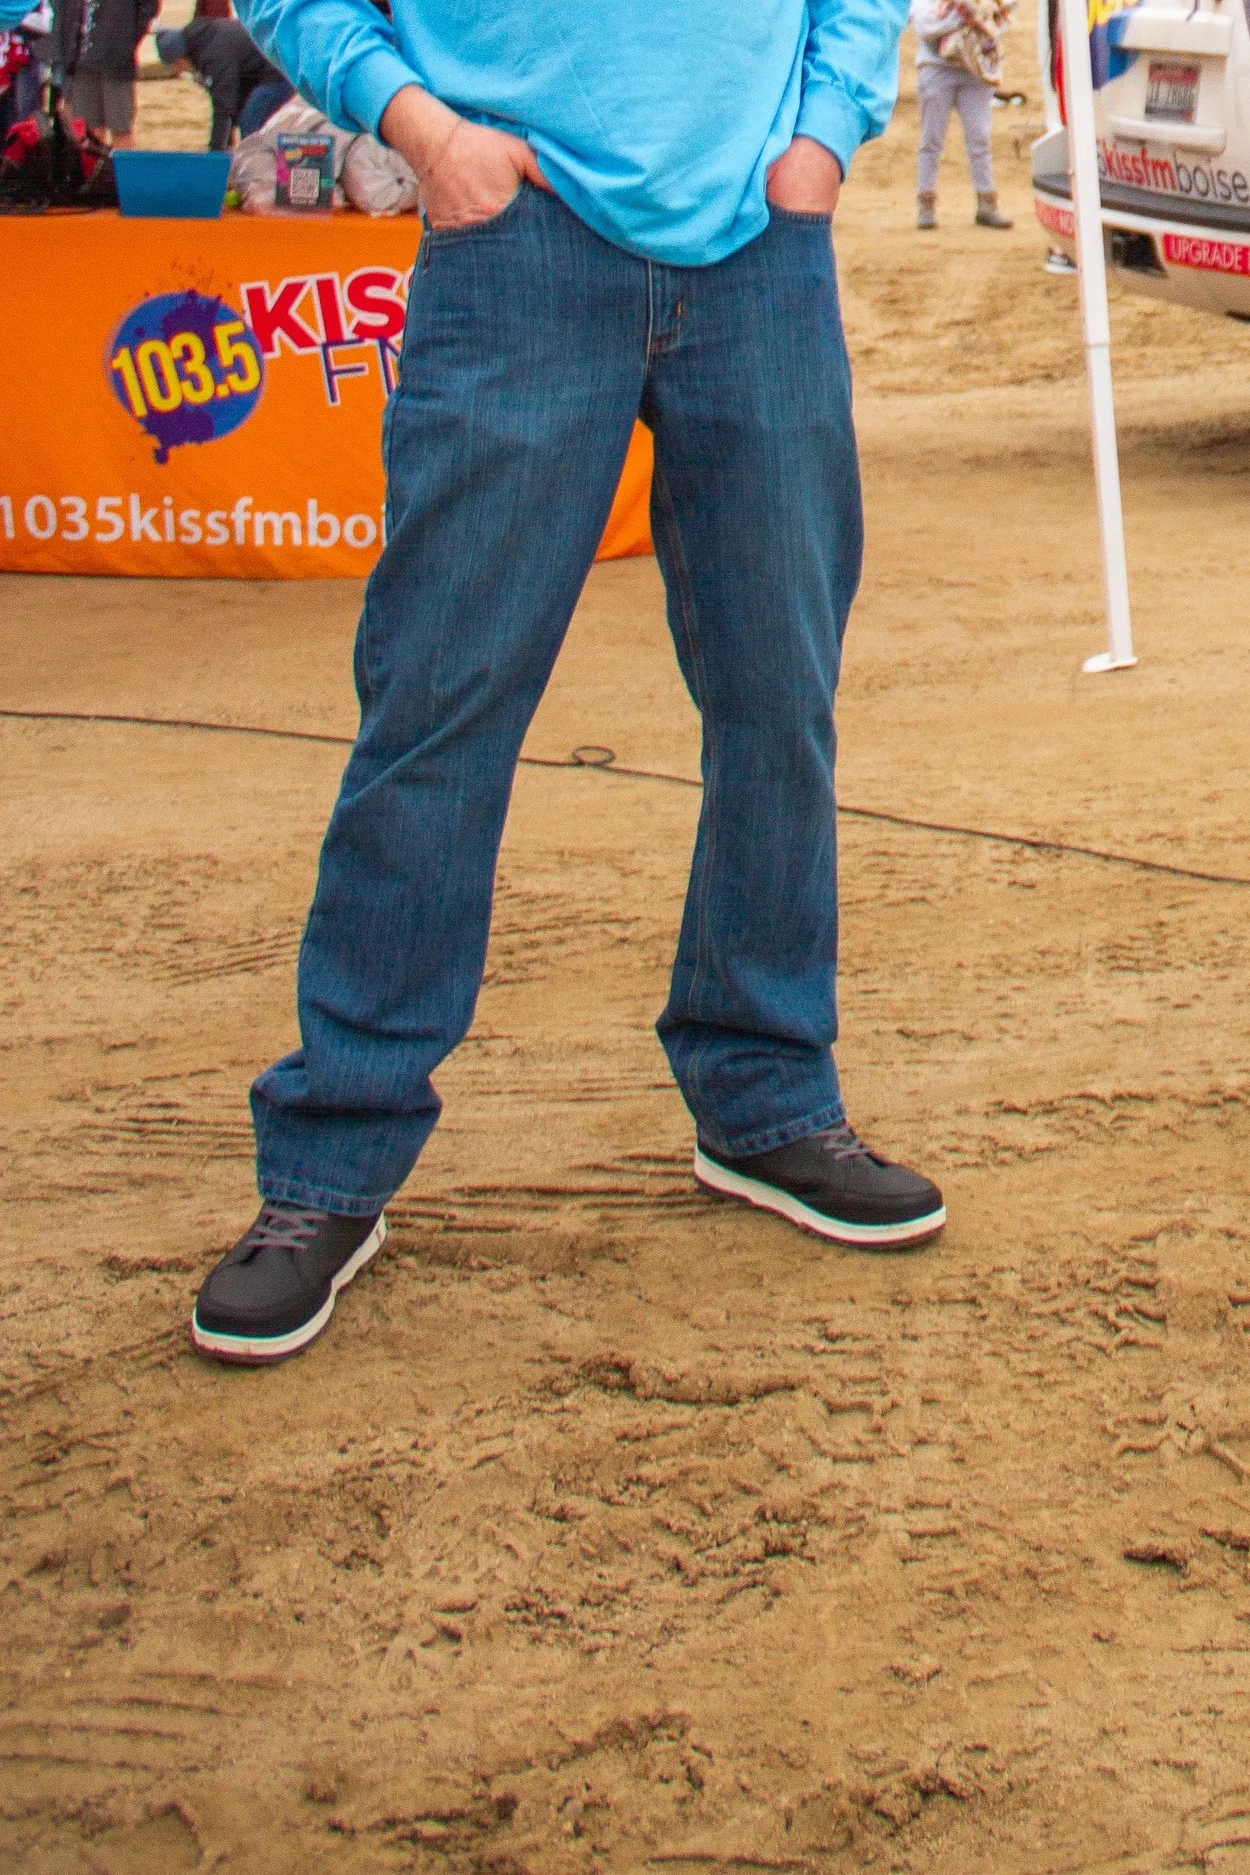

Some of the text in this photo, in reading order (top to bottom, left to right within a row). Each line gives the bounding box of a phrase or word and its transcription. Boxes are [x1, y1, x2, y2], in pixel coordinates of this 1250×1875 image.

[1171, 235, 1243, 271] UPGRADE
[110, 265, 415, 418] 103.5 KIS
